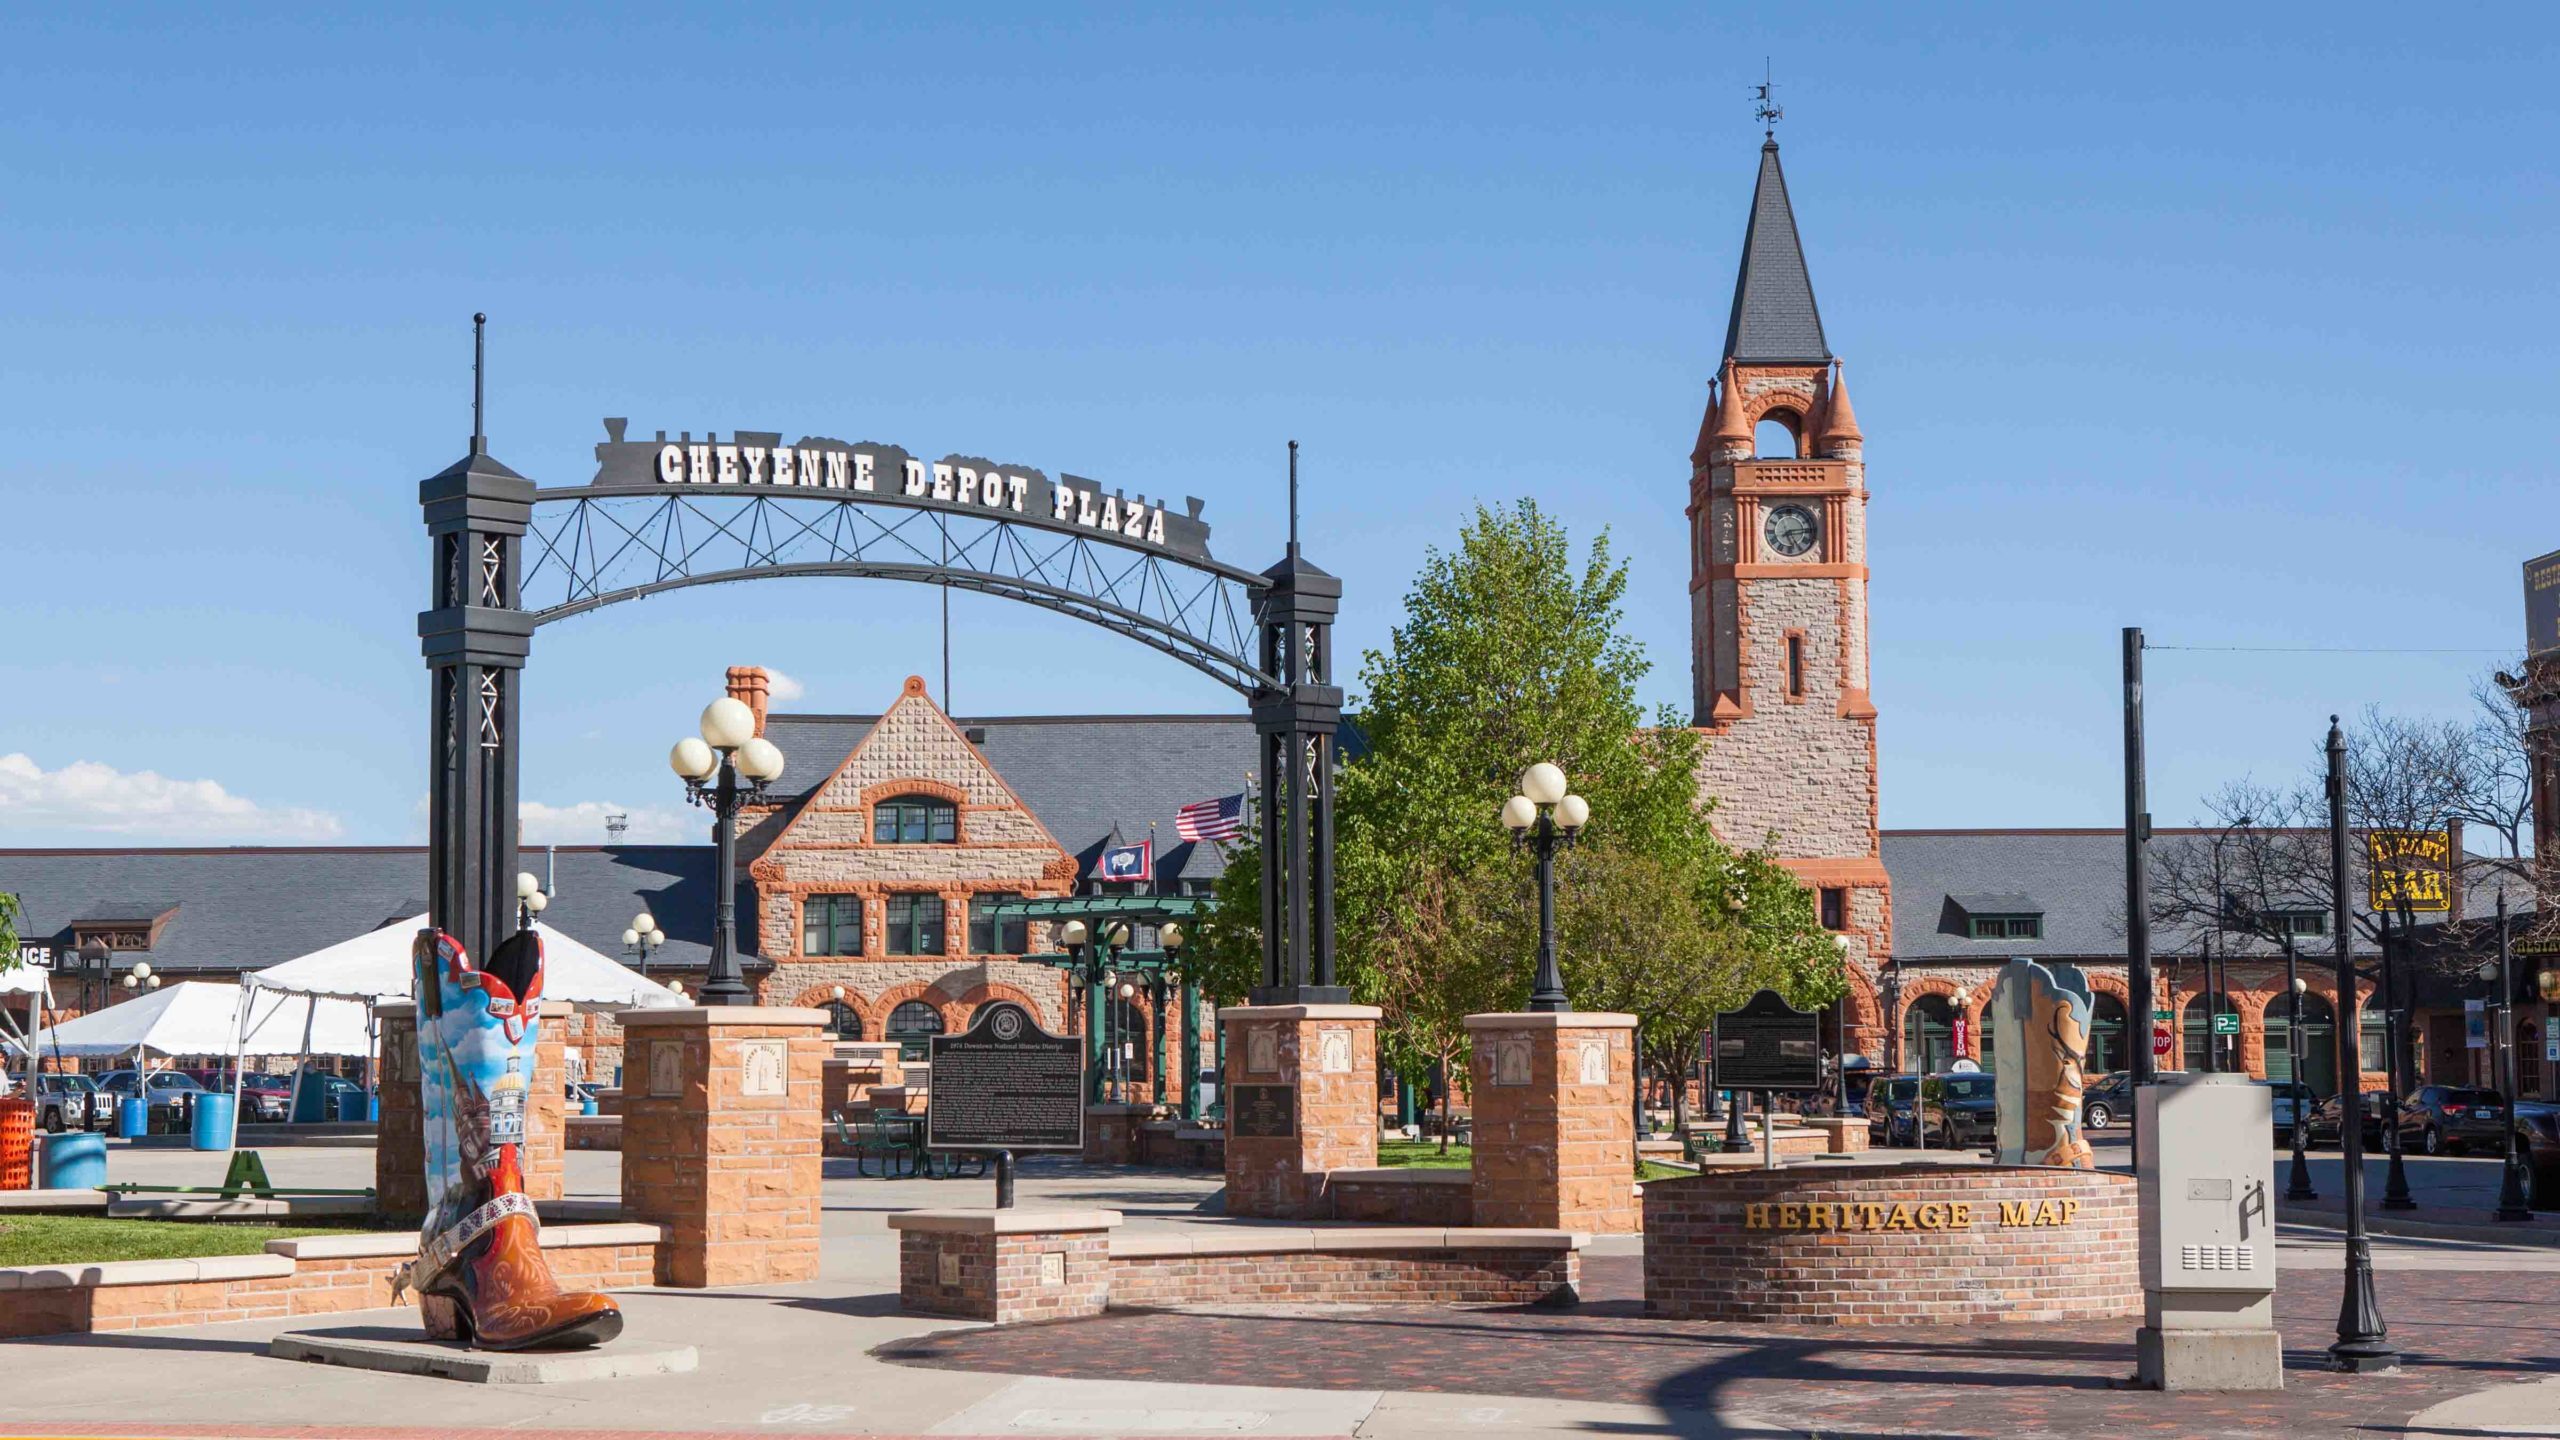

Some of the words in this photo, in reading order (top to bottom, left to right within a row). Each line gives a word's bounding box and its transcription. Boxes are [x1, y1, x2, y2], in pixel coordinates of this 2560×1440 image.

[658, 444, 875, 492] CHEYENNE
[904, 459, 1028, 513] DEPOT
[1054, 484, 1166, 546] PLAZA
[11, 947, 51, 964] ICE
[994, 1042, 1018, 1050] National
[1956, 1020, 1966, 1056] MUSEUM
[2152, 1036, 2171, 1048] TOP
[1744, 1202, 1972, 1229] HERITAGE
[1999, 1197, 2080, 1227] MAP
